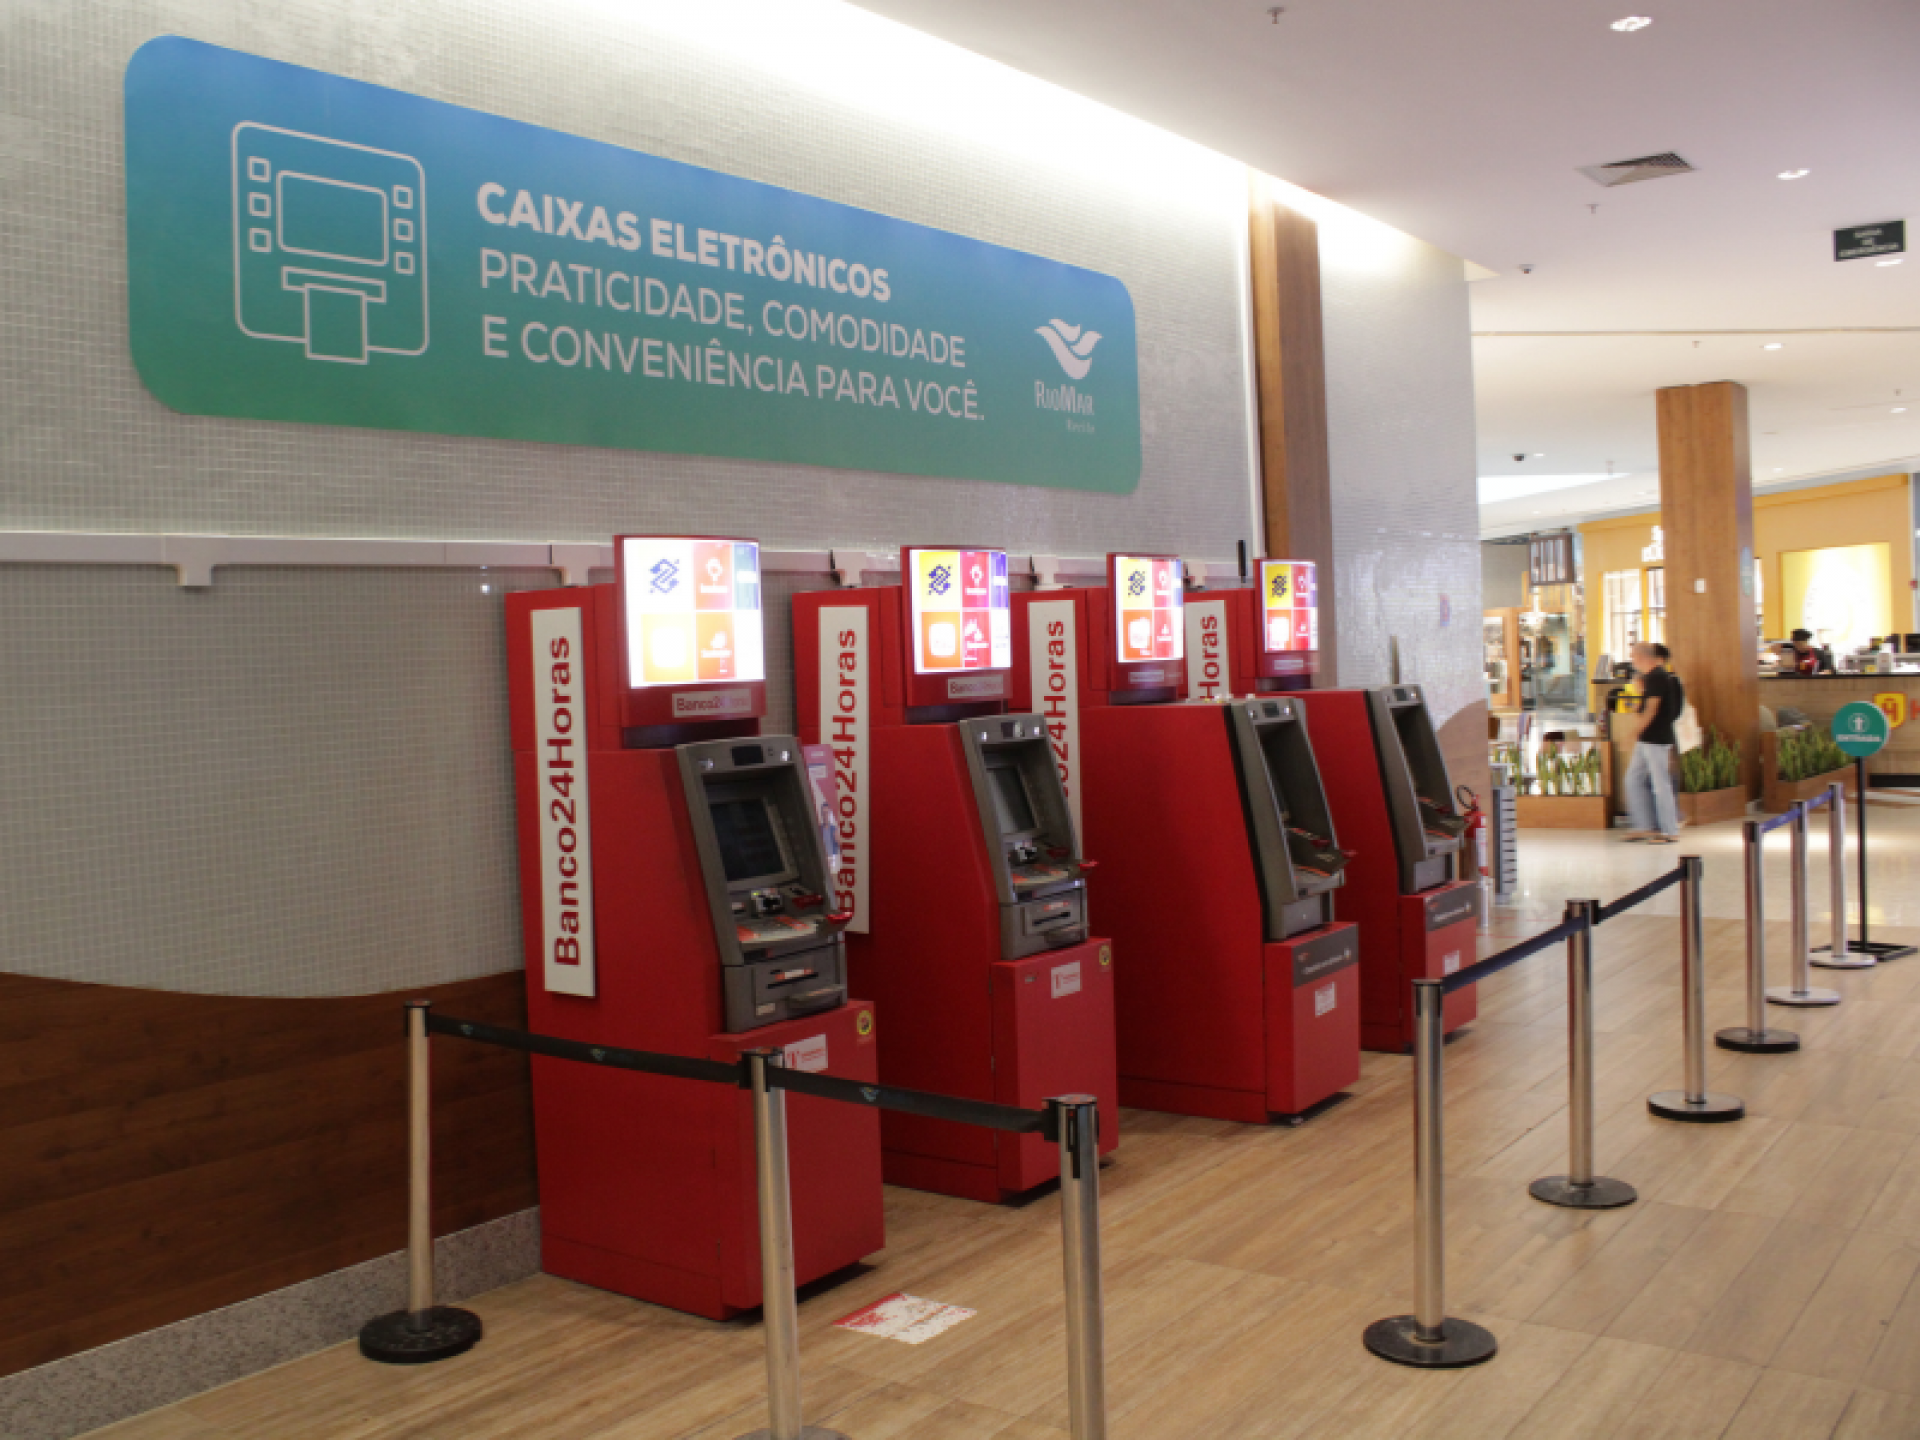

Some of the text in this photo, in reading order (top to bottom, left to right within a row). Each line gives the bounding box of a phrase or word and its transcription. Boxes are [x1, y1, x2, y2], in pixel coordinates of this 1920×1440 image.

[477, 181, 891, 303] CAIXAS ELETRÔNICOS
[480, 247, 966, 368] PRATICIDADE, COMODIDADE
[482, 314, 985, 421] E CONVENIÊNCIA PARA VOCÊ.
[1198, 614, 1221, 699] Horas
[547, 636, 582, 966] Banco24Horas
